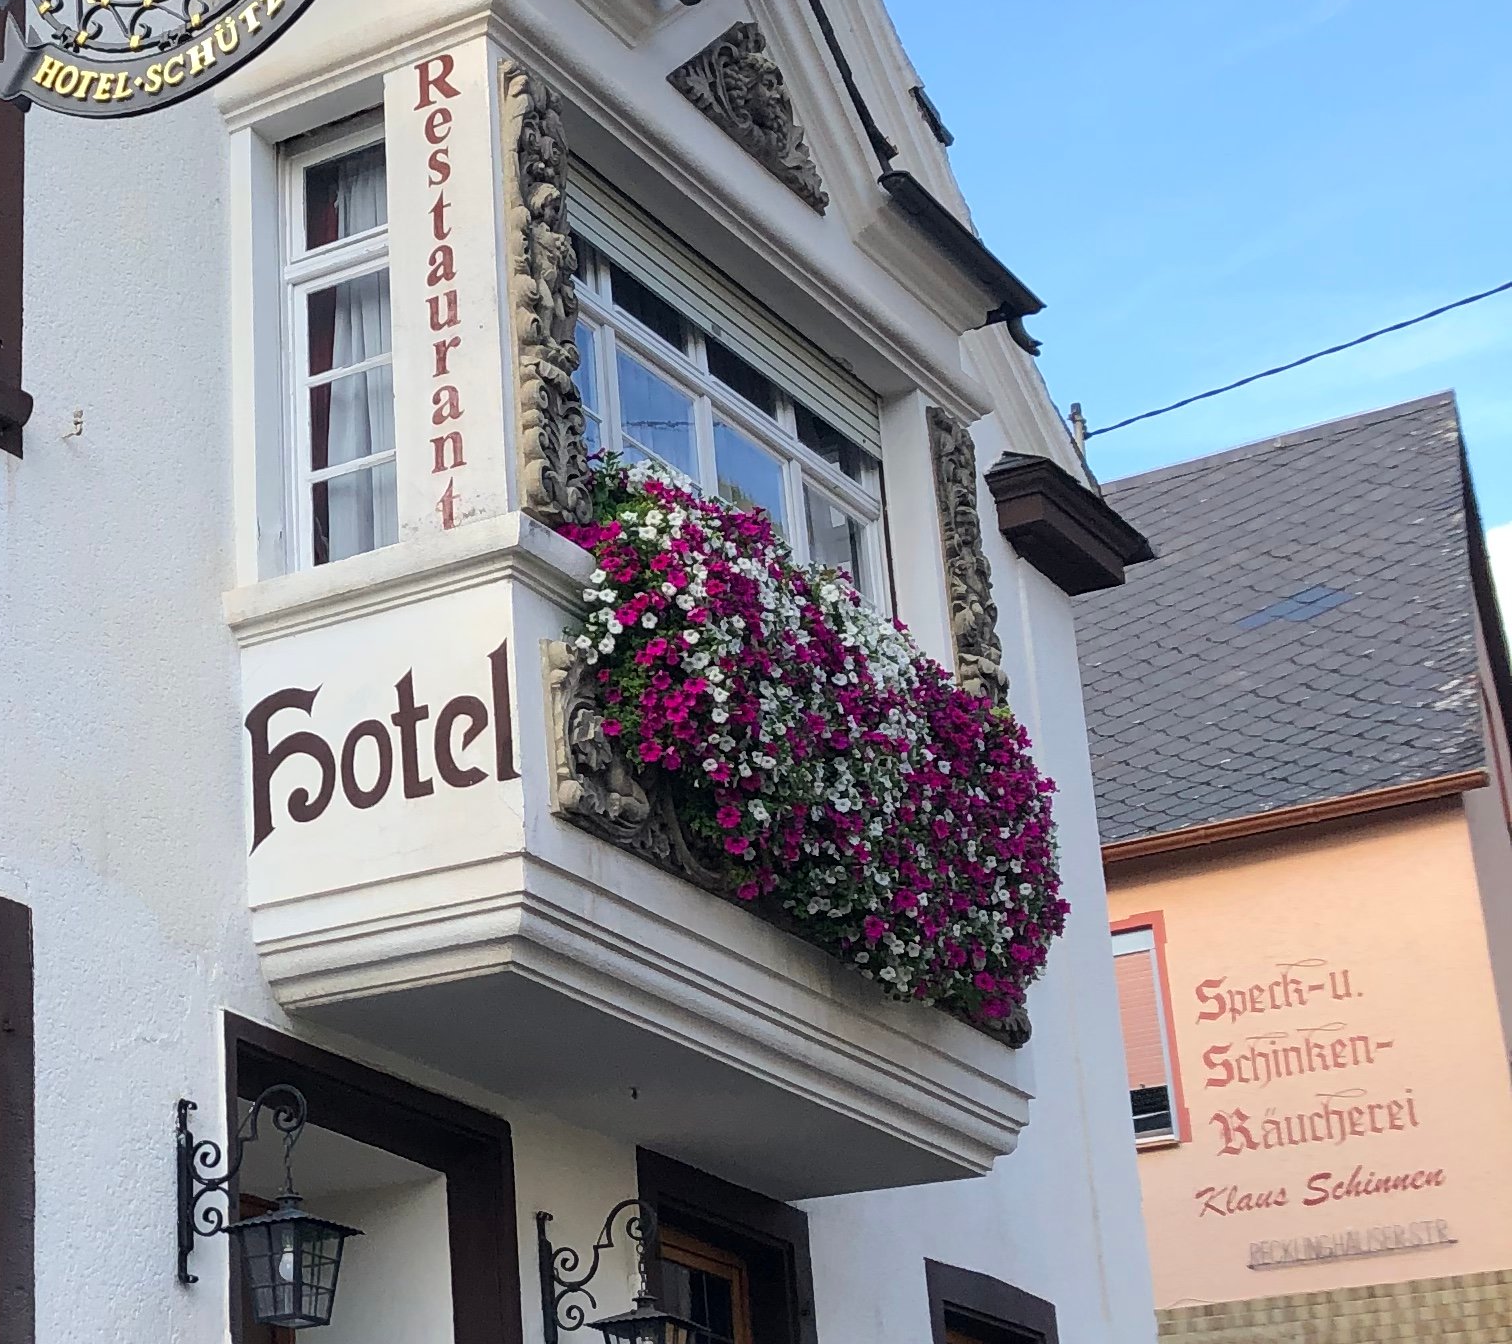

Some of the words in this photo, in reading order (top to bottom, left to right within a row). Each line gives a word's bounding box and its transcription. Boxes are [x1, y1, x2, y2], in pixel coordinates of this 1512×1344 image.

[413, 52, 468, 531] Restaurant
[244, 637, 521, 857] Hotel
[1208, 1089, 1420, 1157] Räucherei
[1195, 1186, 1288, 1218] Klaus
